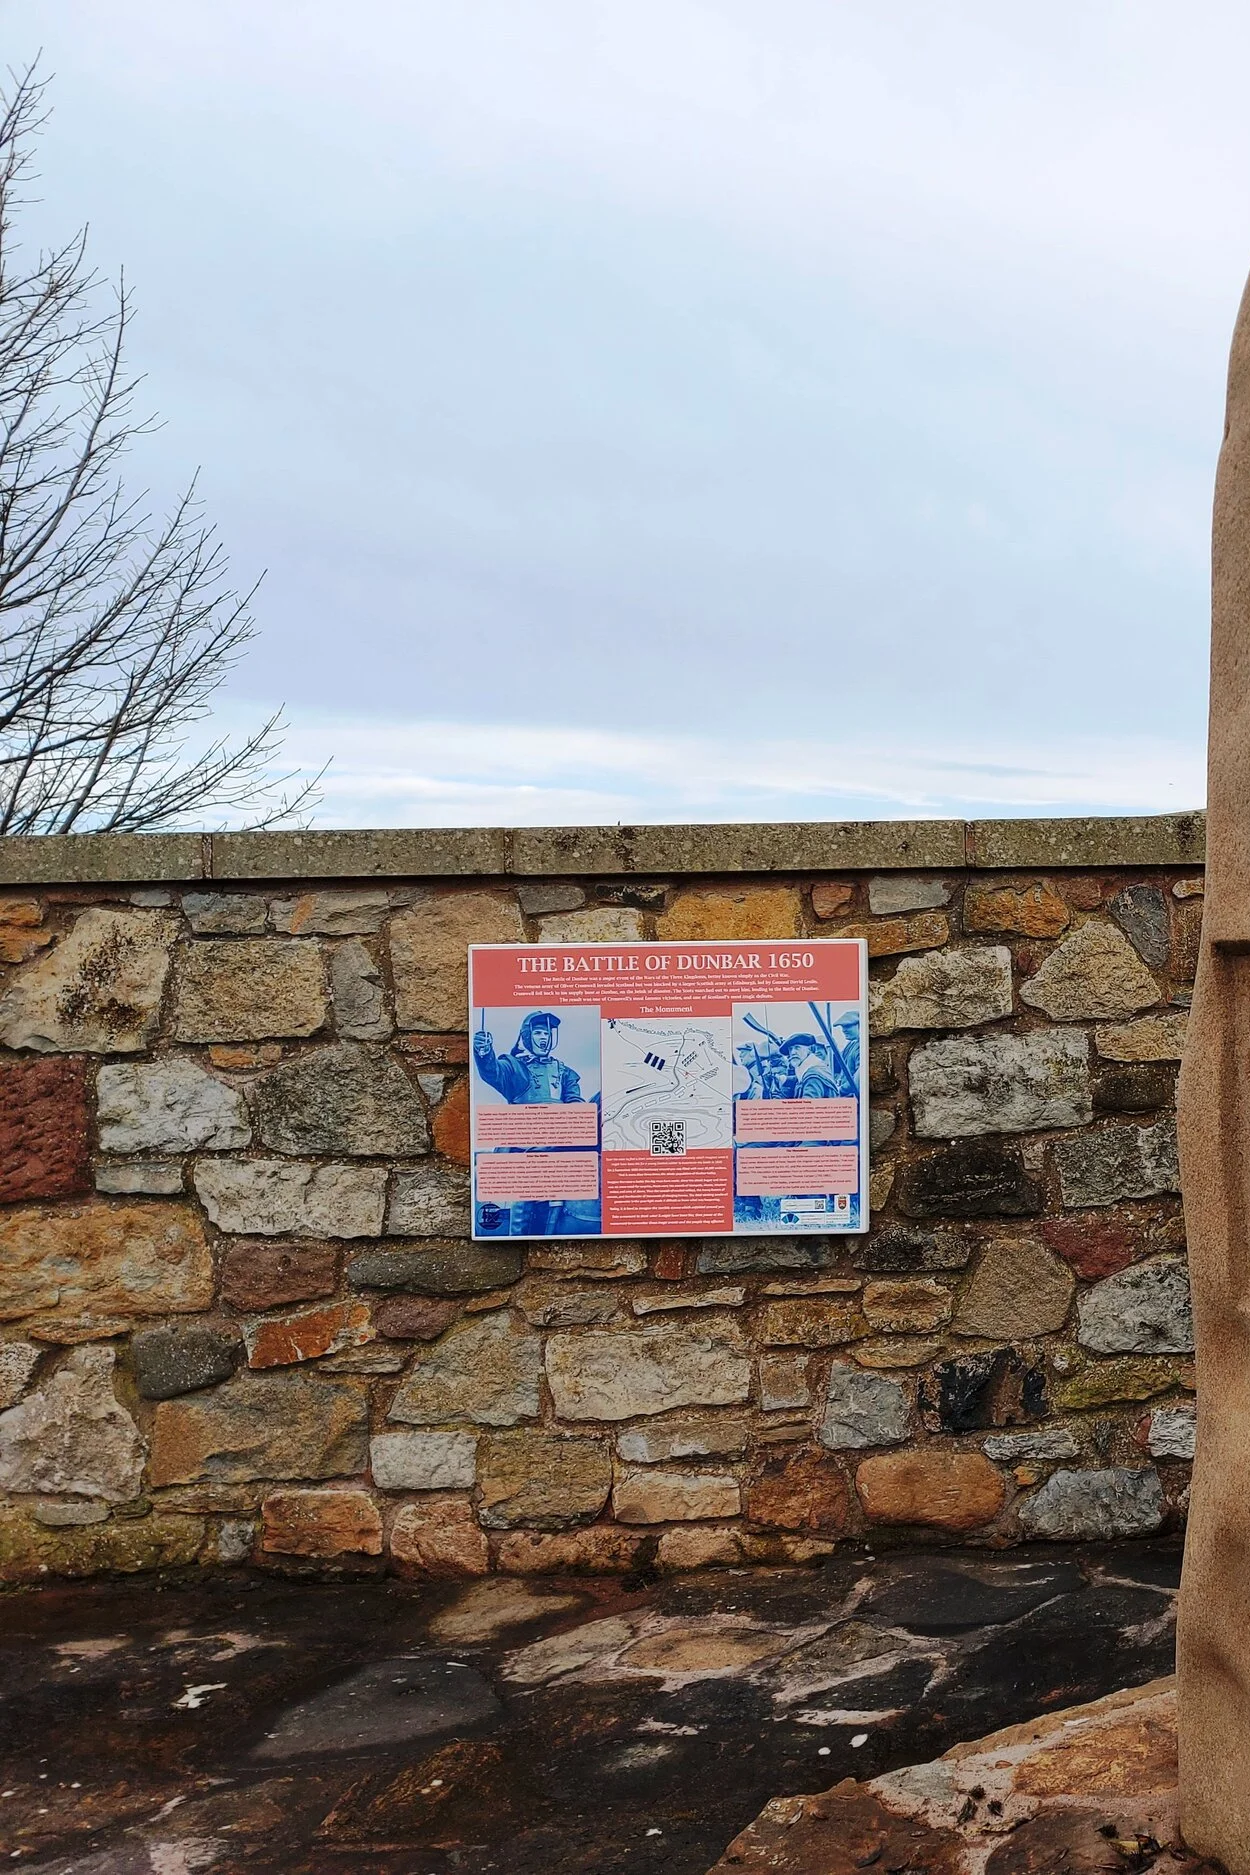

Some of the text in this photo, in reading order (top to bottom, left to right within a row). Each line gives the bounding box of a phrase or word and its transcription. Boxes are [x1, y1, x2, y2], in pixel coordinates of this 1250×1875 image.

[517, 952, 814, 972] THE BATTLE OF DUNBAR 1650
